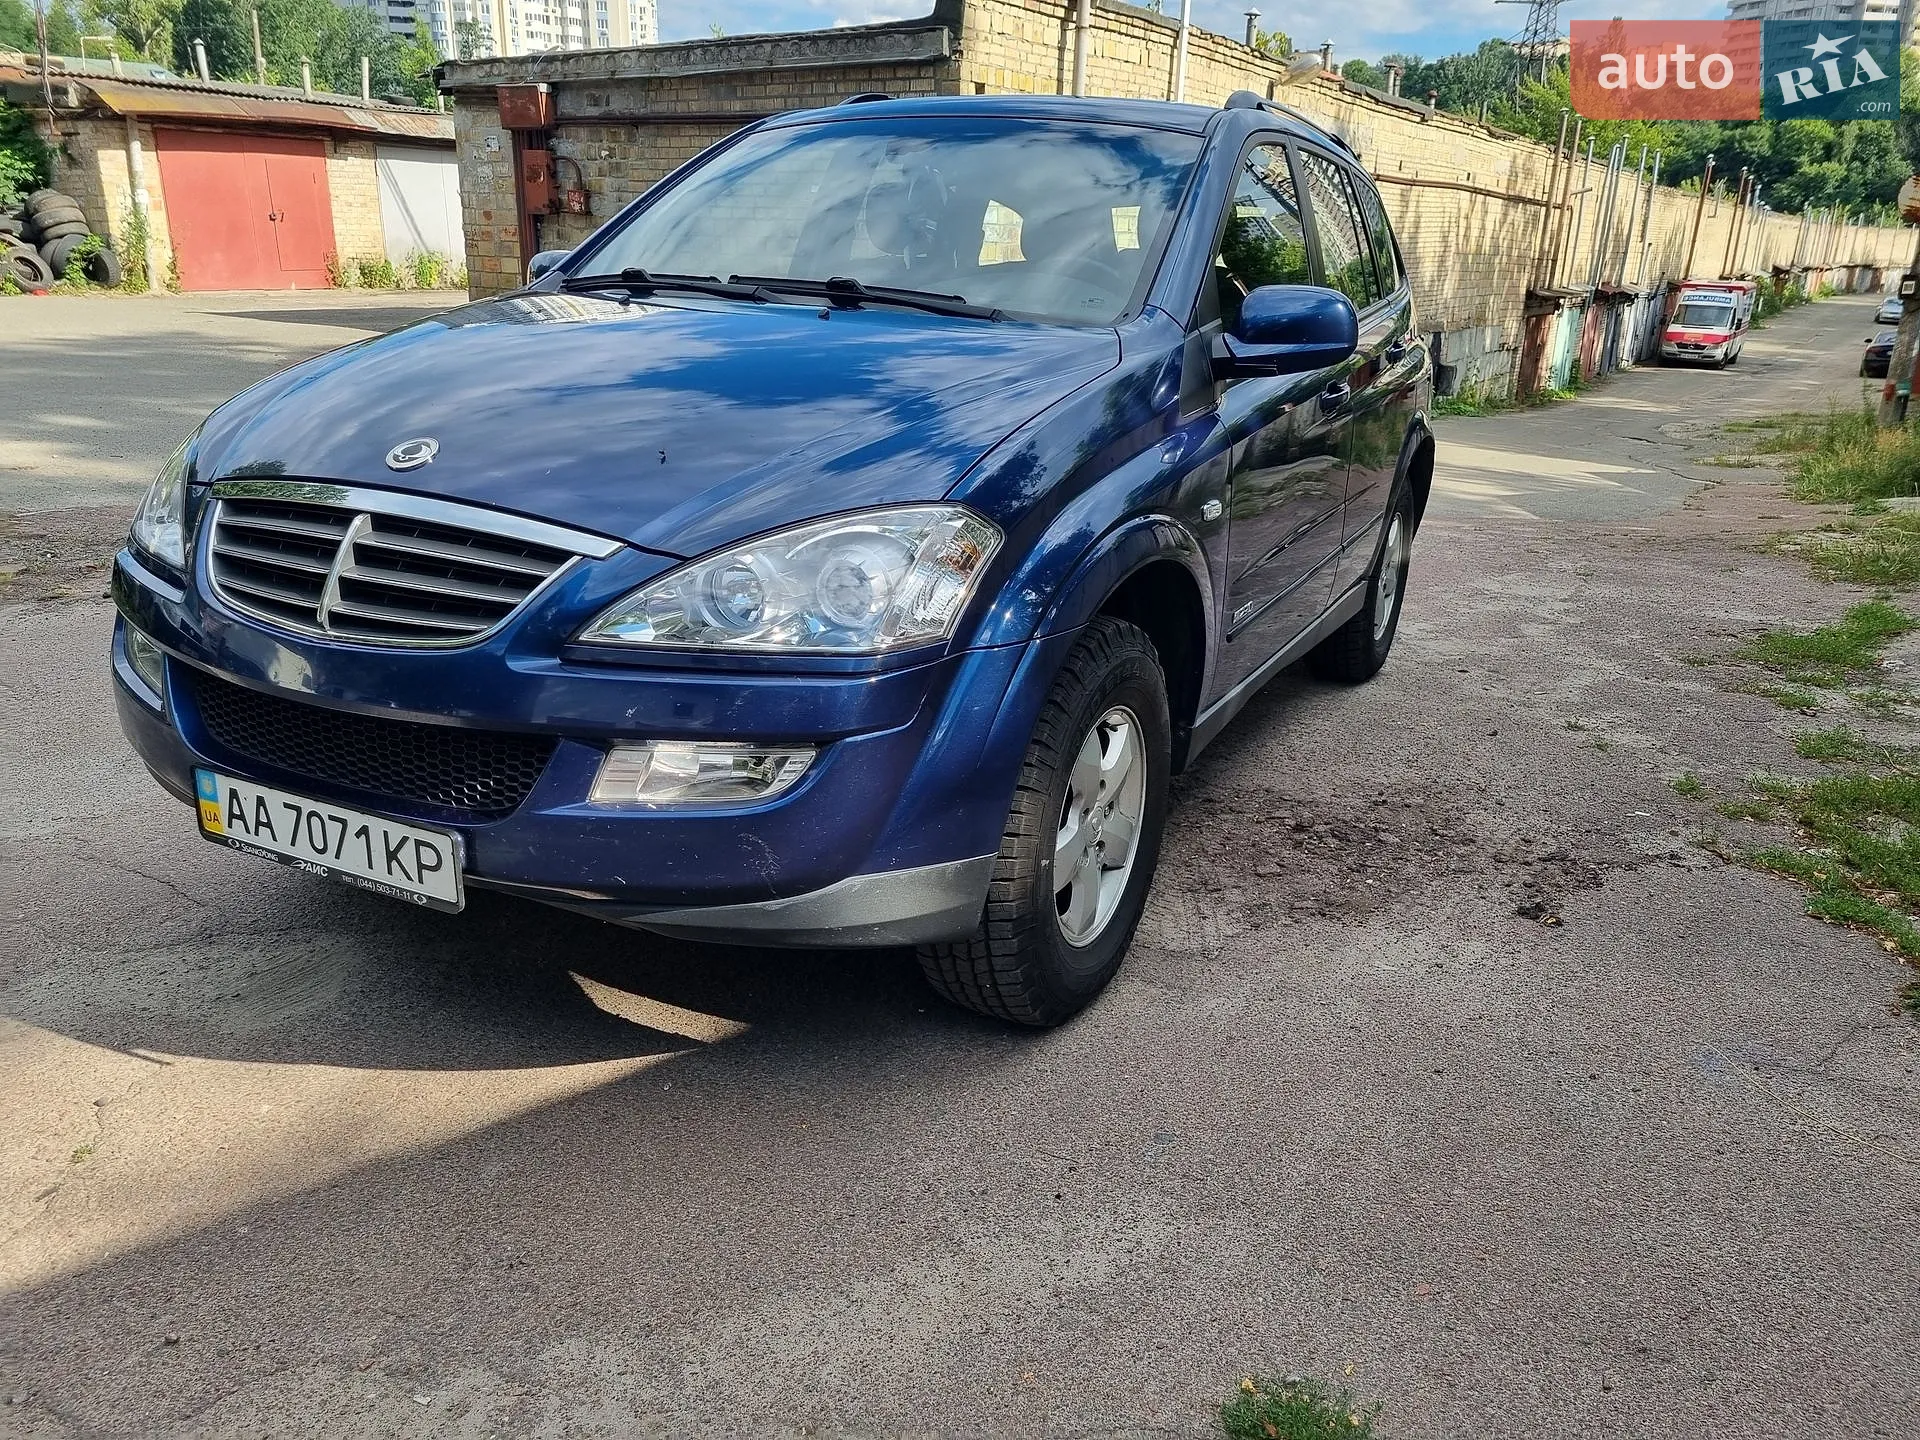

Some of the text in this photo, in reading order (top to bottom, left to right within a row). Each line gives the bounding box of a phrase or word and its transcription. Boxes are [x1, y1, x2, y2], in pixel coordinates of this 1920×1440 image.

[204, 808, 221, 826] UA
[357, 878, 376, 892] (044)
[376, 883, 411, 900] 503-71-11
